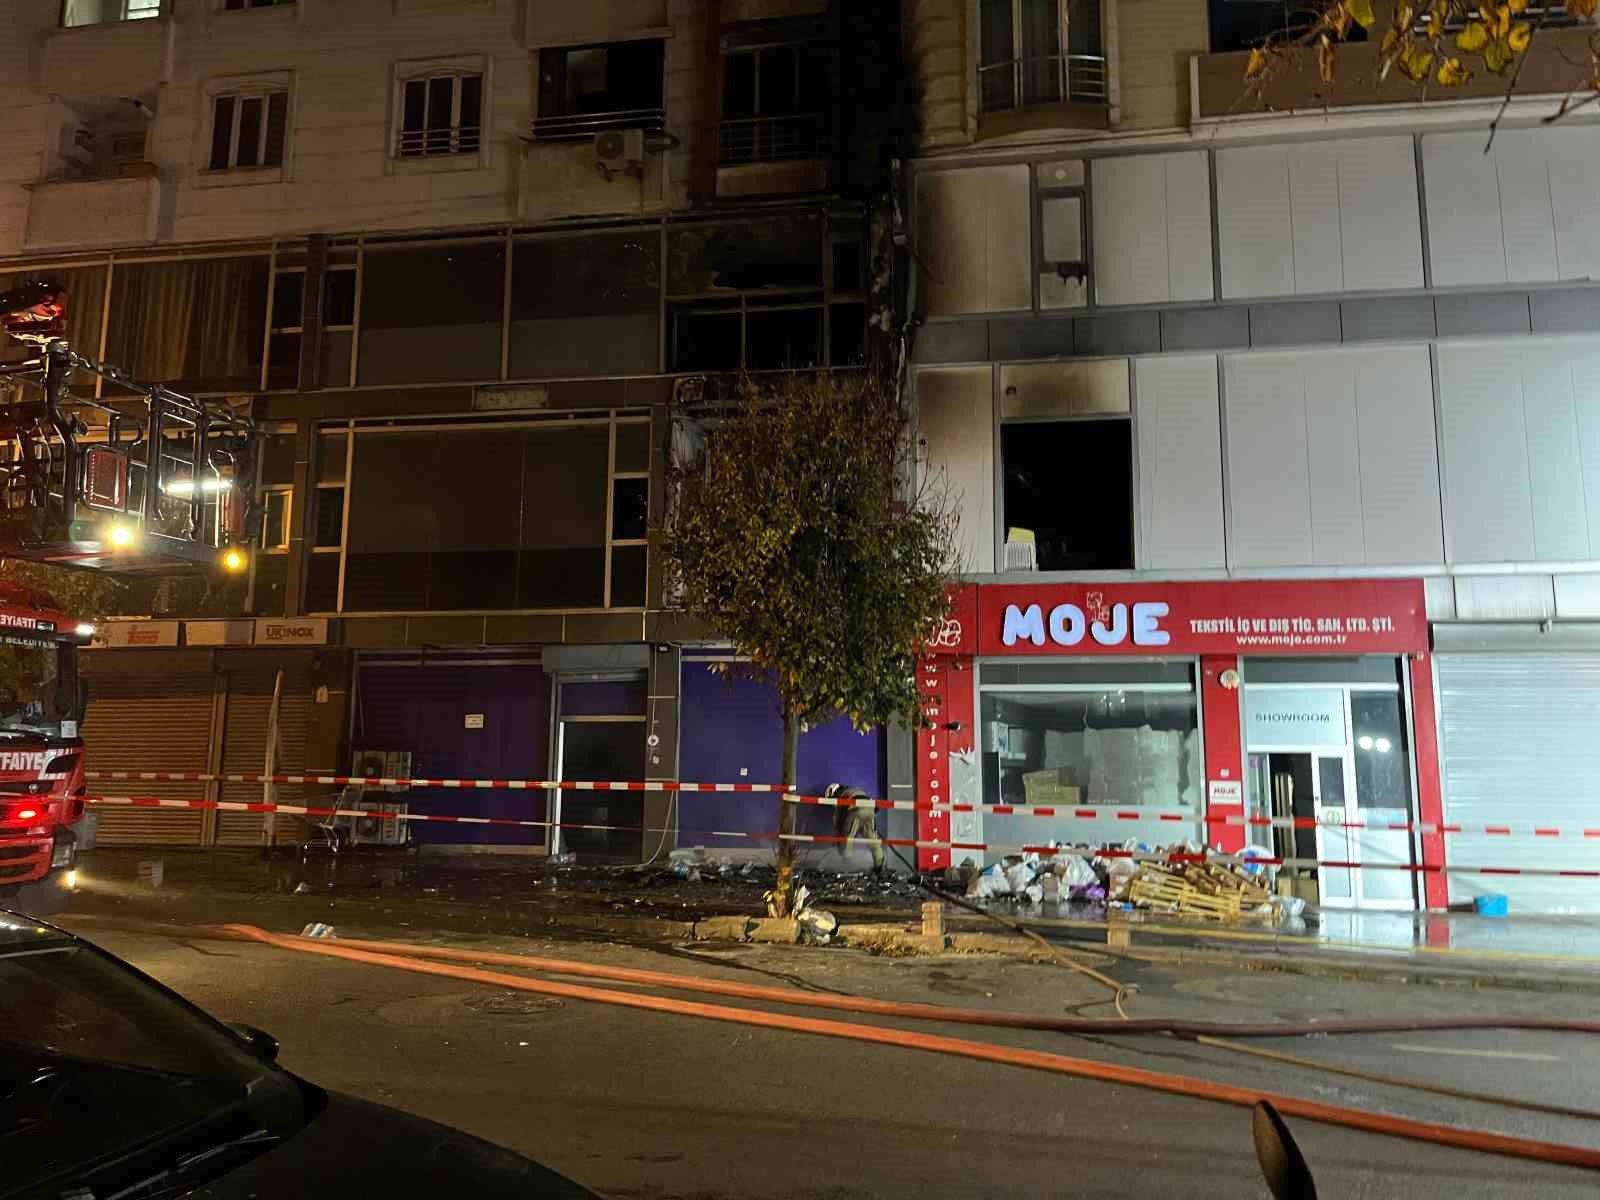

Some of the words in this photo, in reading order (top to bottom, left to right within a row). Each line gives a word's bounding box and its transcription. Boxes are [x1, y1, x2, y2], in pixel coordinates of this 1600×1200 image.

[1002, 602, 1171, 646] MOJE
[1190, 616, 1235, 633] TEKSTİL
[1252, 618, 1267, 633] VE
[1316, 617, 1345, 633] SAN.
[1346, 617, 1371, 633] LTD.
[1255, 712, 1330, 722] SHOWROOM
